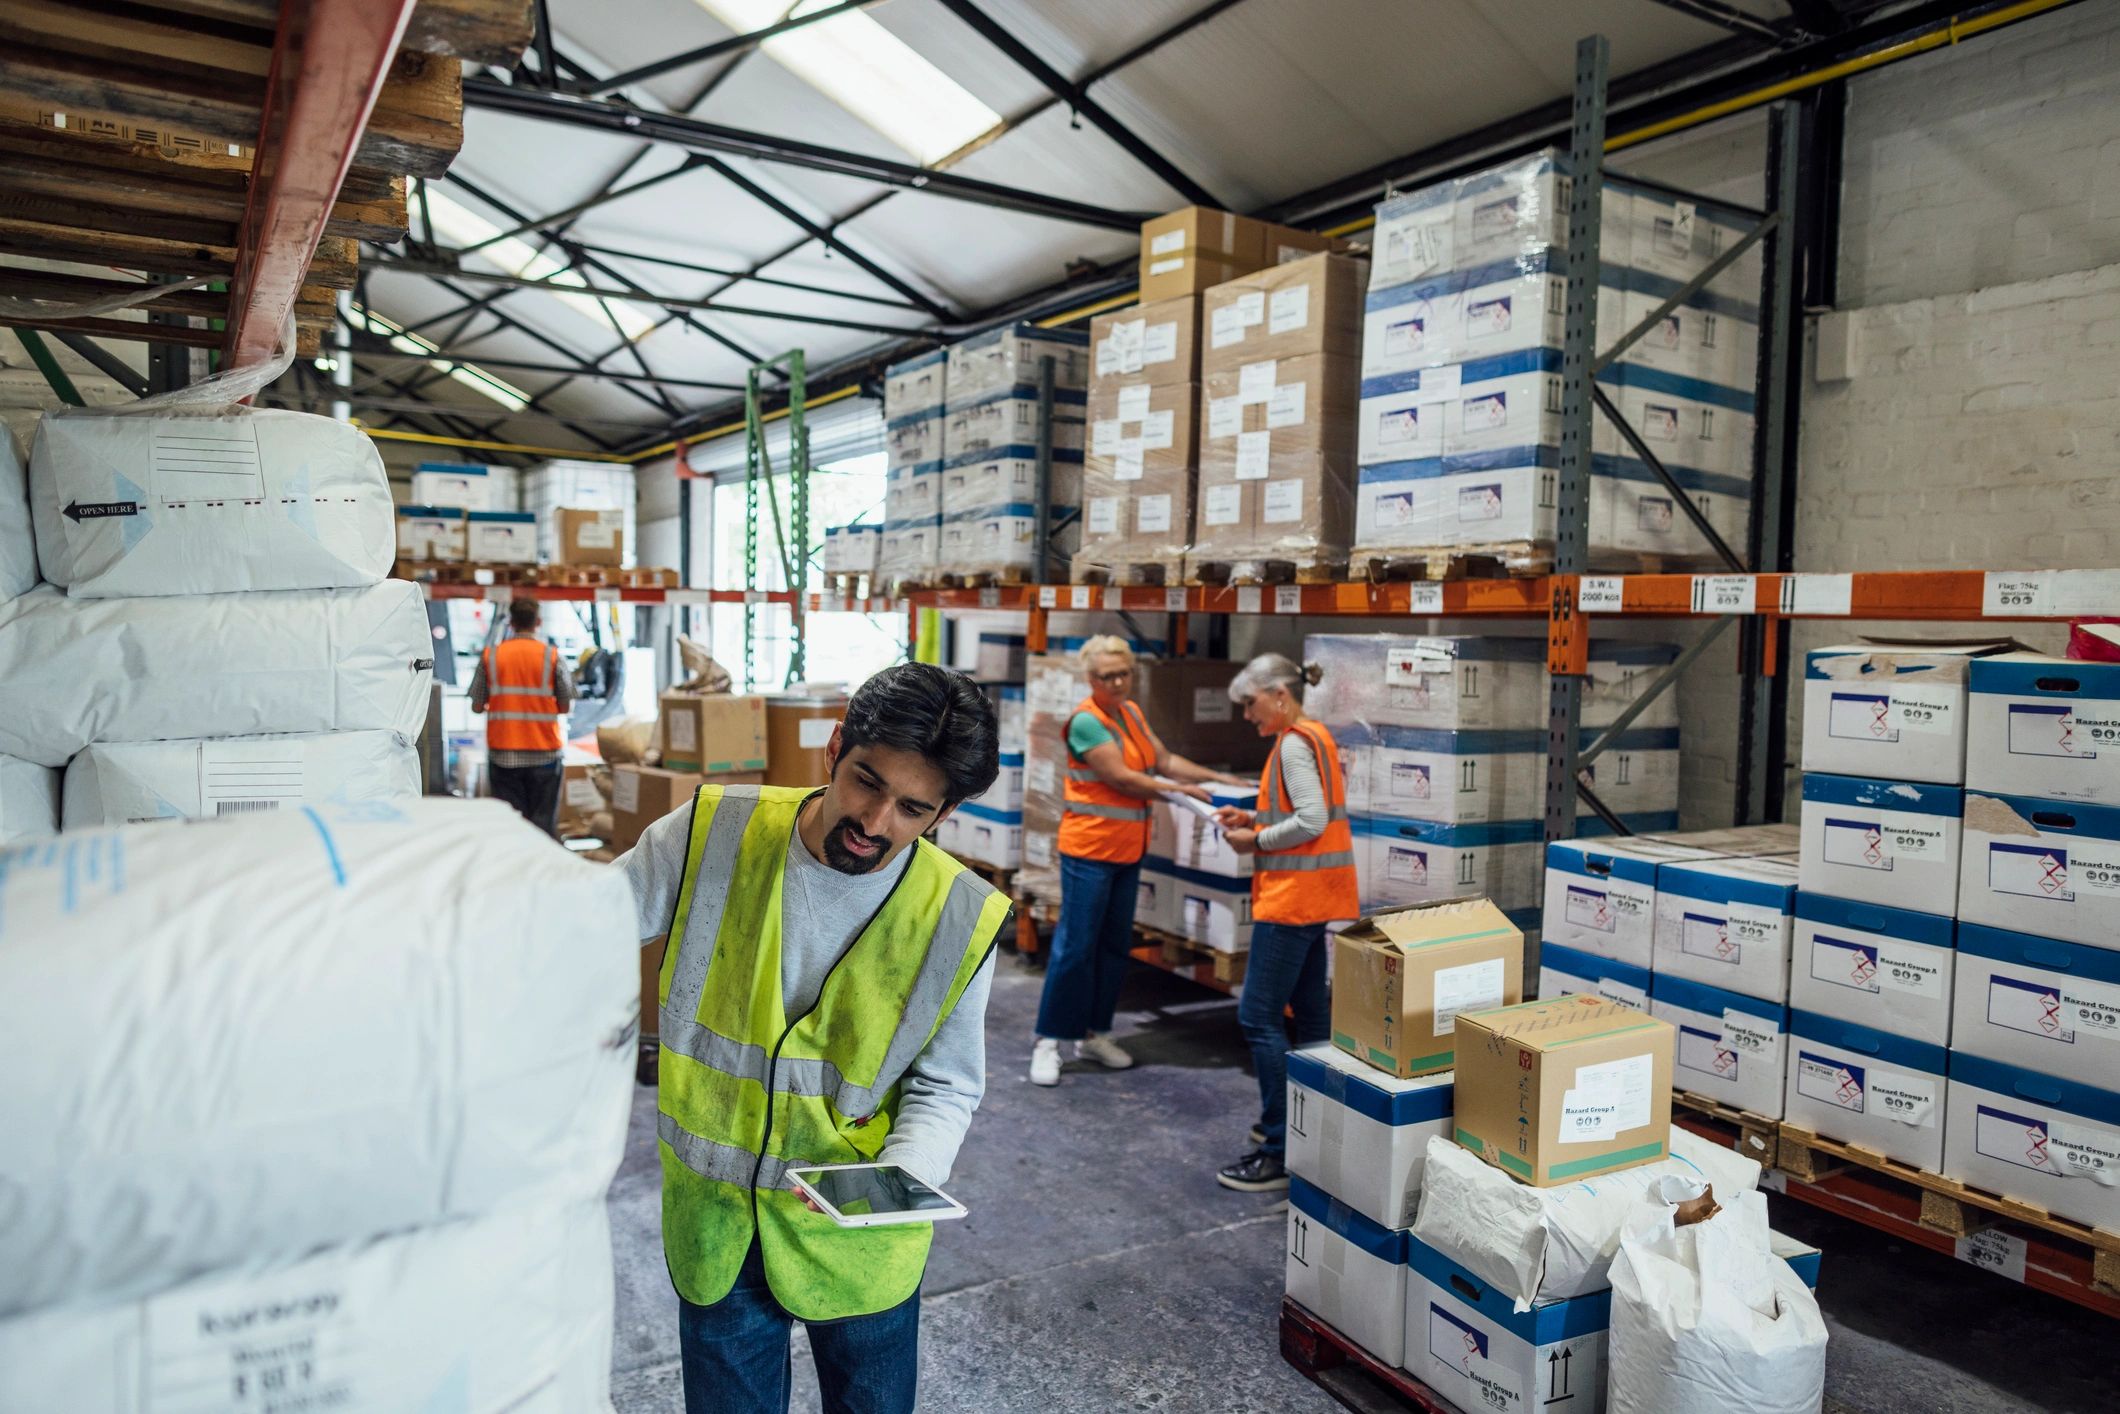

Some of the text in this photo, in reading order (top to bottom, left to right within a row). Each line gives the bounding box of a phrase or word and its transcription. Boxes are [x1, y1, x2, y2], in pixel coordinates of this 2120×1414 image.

[80, 504, 134, 515] OPEN HERE
[1998, 582, 2039, 590] Flag: 75kg
[1582, 592, 1603, 601] 2000
[1892, 699, 1918, 707] Hazard
[1919, 702, 1942, 711] Group
[2075, 718, 2108, 726] Hazard
[1884, 826, 1909, 835] Hazard
[2070, 859, 2102, 868] Hazard
[1729, 917, 1750, 925] Hazard
[1752, 920, 1770, 929] Group
[1880, 957, 1906, 967] Hazard
[1908, 963, 1930, 973] Group
[2064, 996, 2120, 1013] Hazard Grou
[1872, 1085, 1898, 1096] Hazard
[1899, 1091, 1922, 1102] Group
[2051, 1138, 2083, 1151] Hazard
[2086, 1146, 2115, 1159] Group
[1470, 1370, 1520, 1401] Hazard Group A
